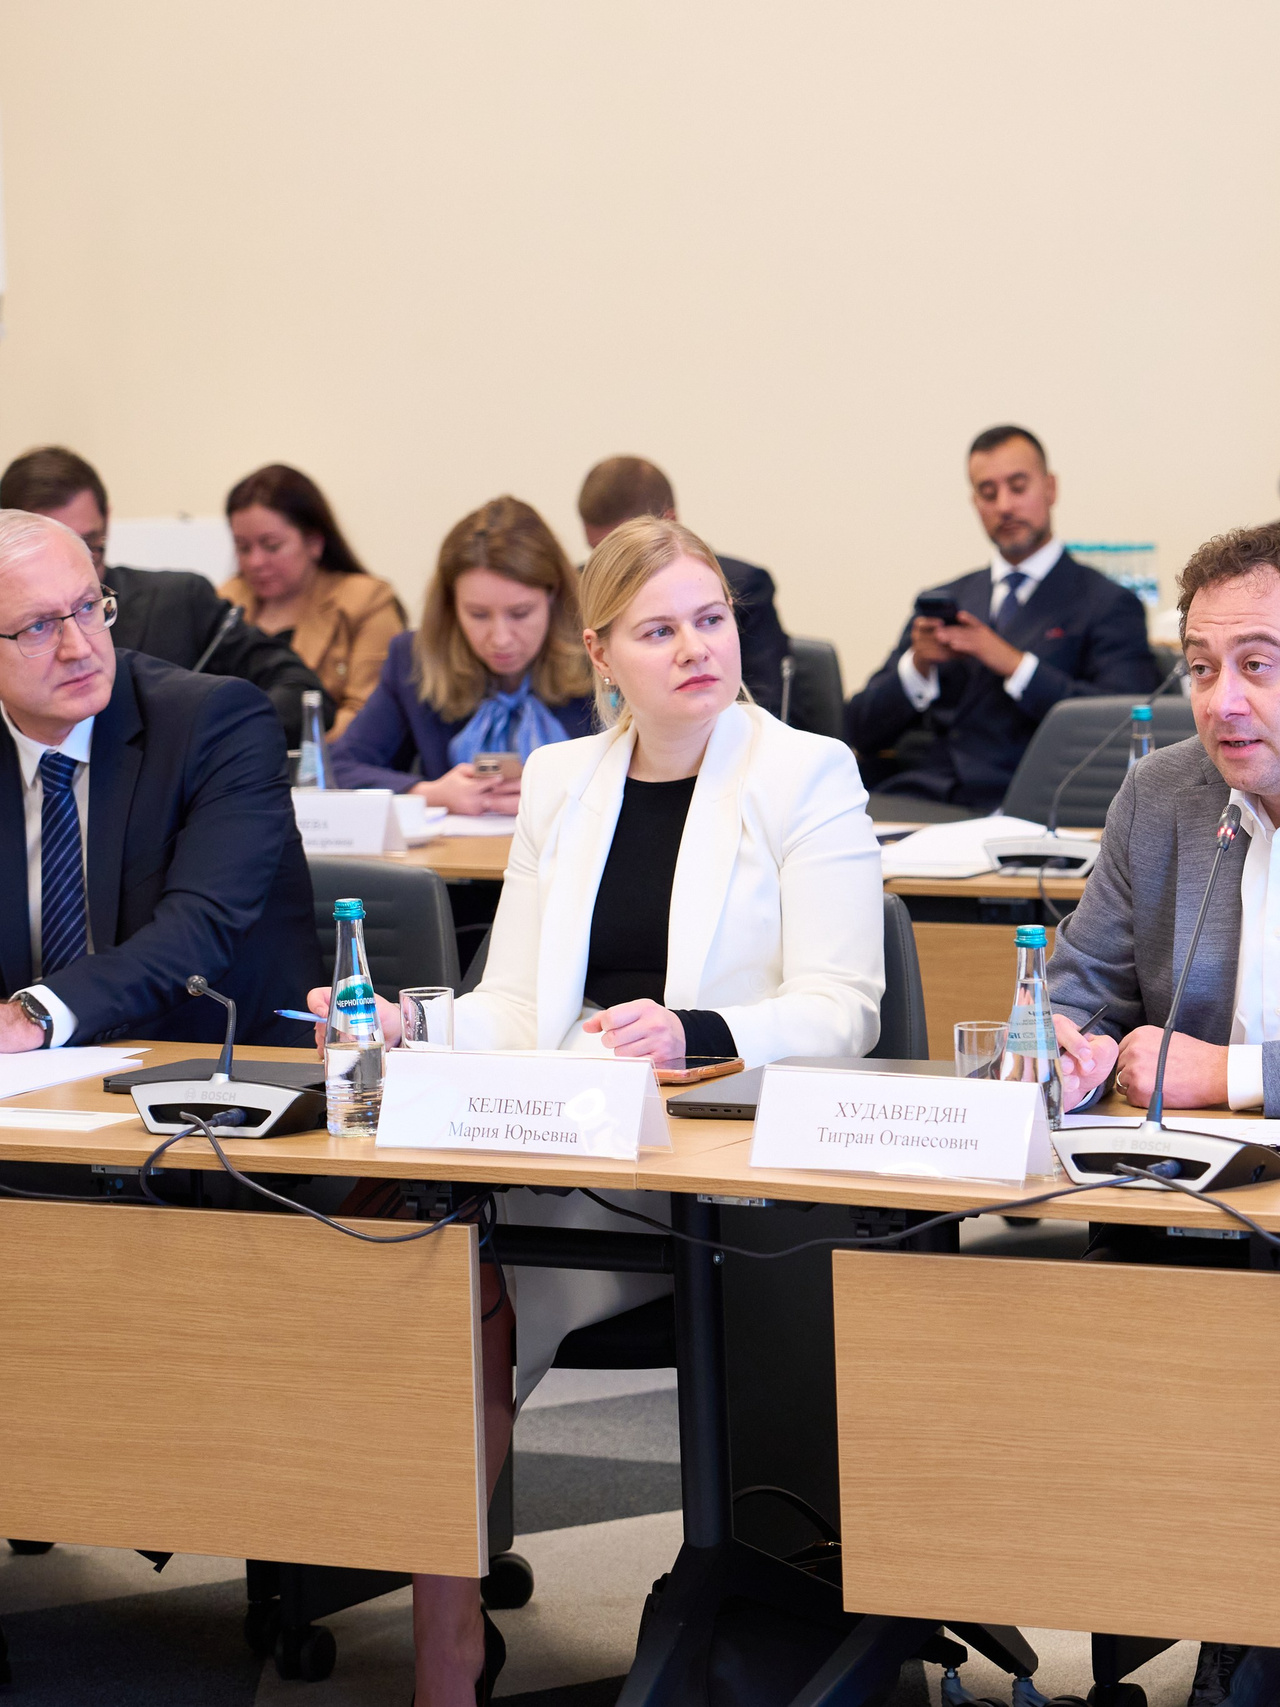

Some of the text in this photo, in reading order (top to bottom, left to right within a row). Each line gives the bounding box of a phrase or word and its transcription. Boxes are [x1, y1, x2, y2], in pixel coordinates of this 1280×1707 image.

[201, 1090, 237, 1102] BOSCH
[467, 1096, 566, 1117] КЕЛЕМБЕТ
[835, 1101, 968, 1125] ХУДАВЕРДЯН
[448, 1121, 578, 1145] Мария Юрьевна
[817, 1126, 979, 1151] Тигран Оганесович
[1131, 1139, 1171, 1152] BOSCH
